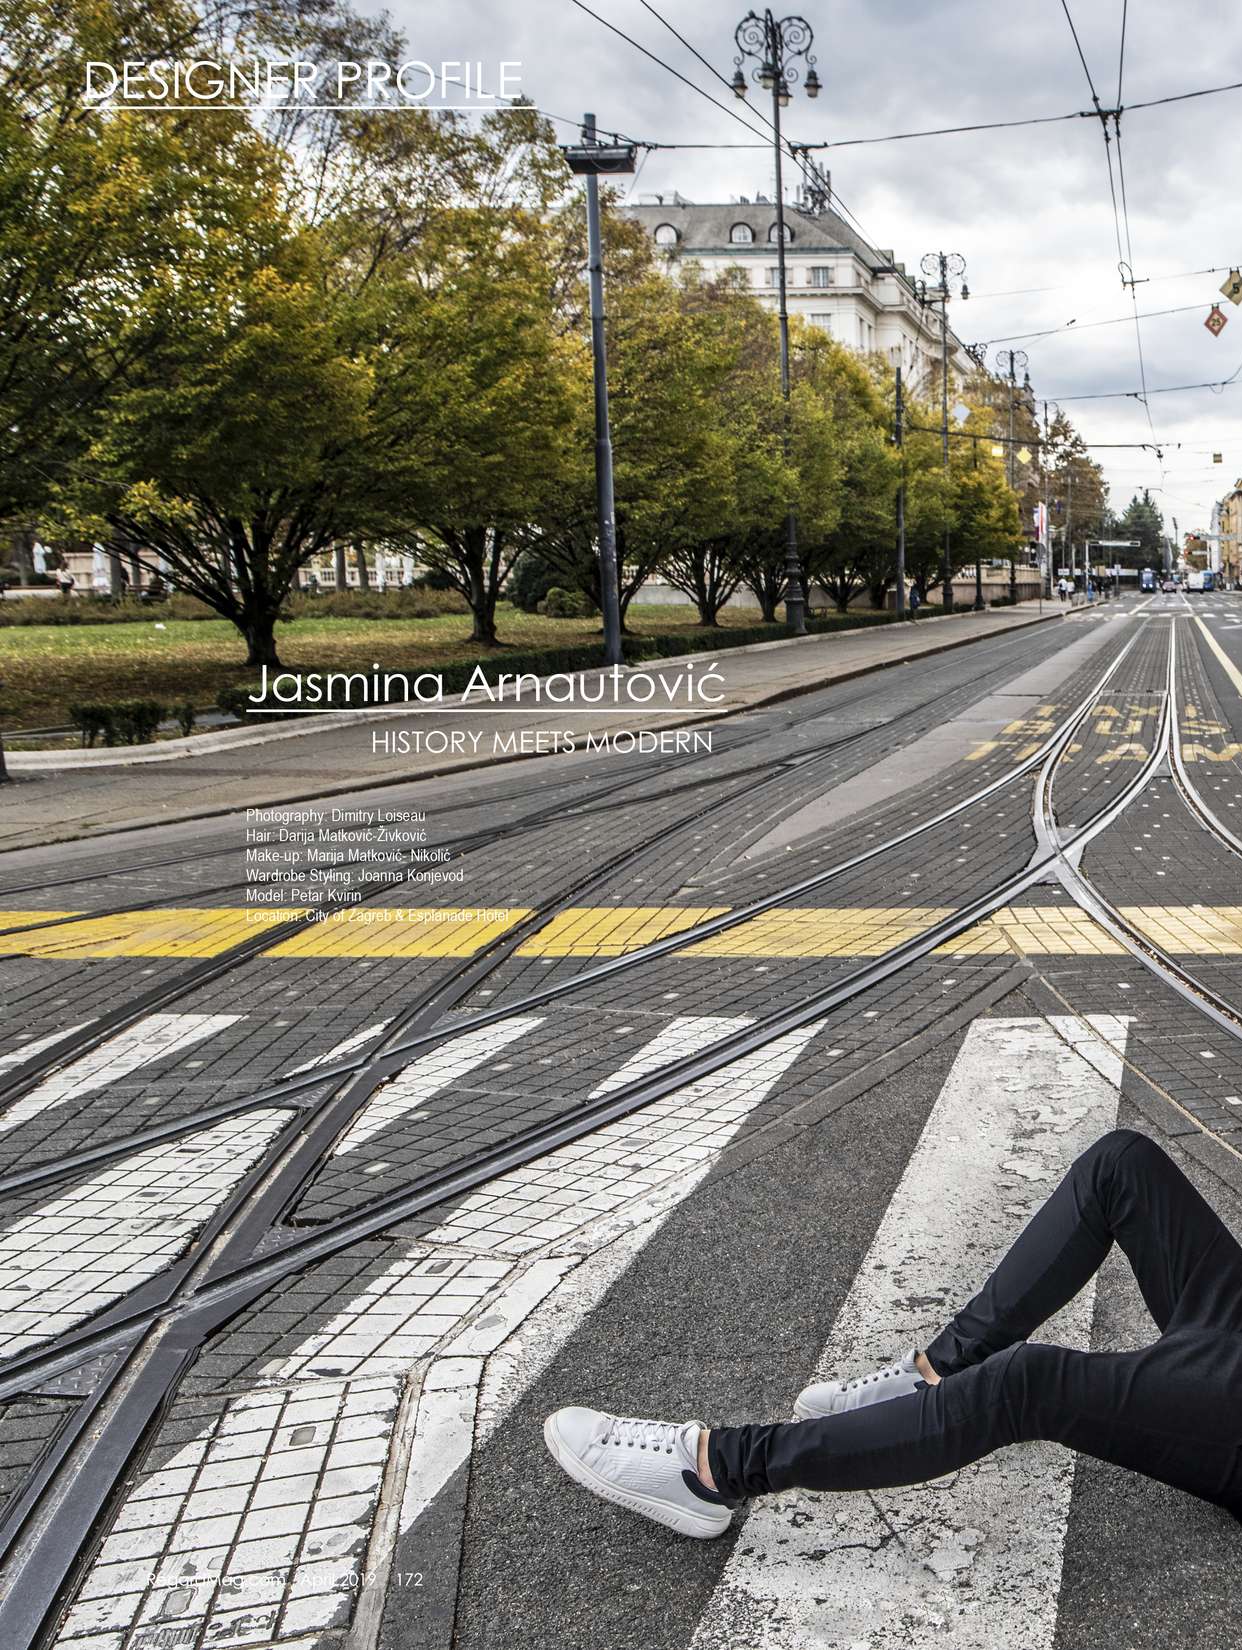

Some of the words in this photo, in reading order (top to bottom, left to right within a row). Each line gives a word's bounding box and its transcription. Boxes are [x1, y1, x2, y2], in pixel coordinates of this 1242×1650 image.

[1232, 283, 1240, 294] 5
[1035, 703, 1198, 719] TAXI
[1001, 719, 1228, 735] BUS
